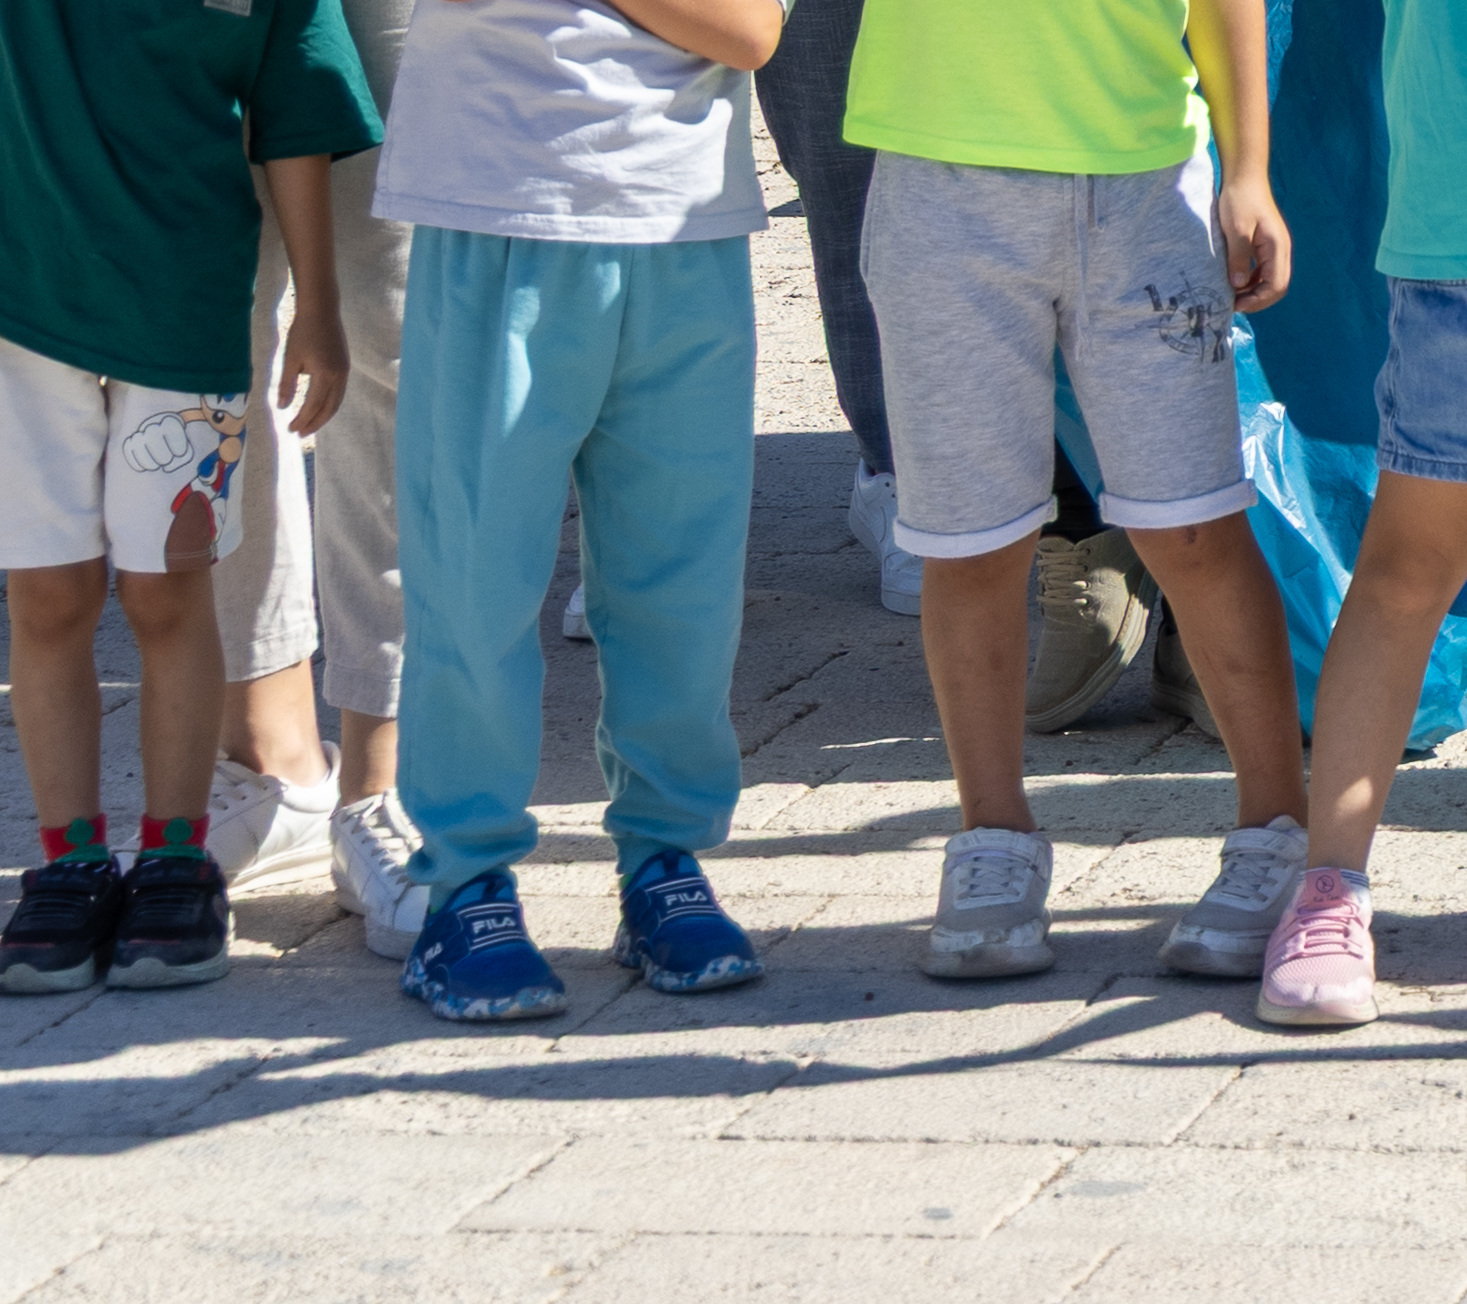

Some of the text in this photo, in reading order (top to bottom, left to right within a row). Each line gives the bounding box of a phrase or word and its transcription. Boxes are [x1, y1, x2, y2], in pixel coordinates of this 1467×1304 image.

[664, 890, 708, 906] FILA
[472, 916, 516, 934] FILA
[423, 943, 444, 965] FILA
